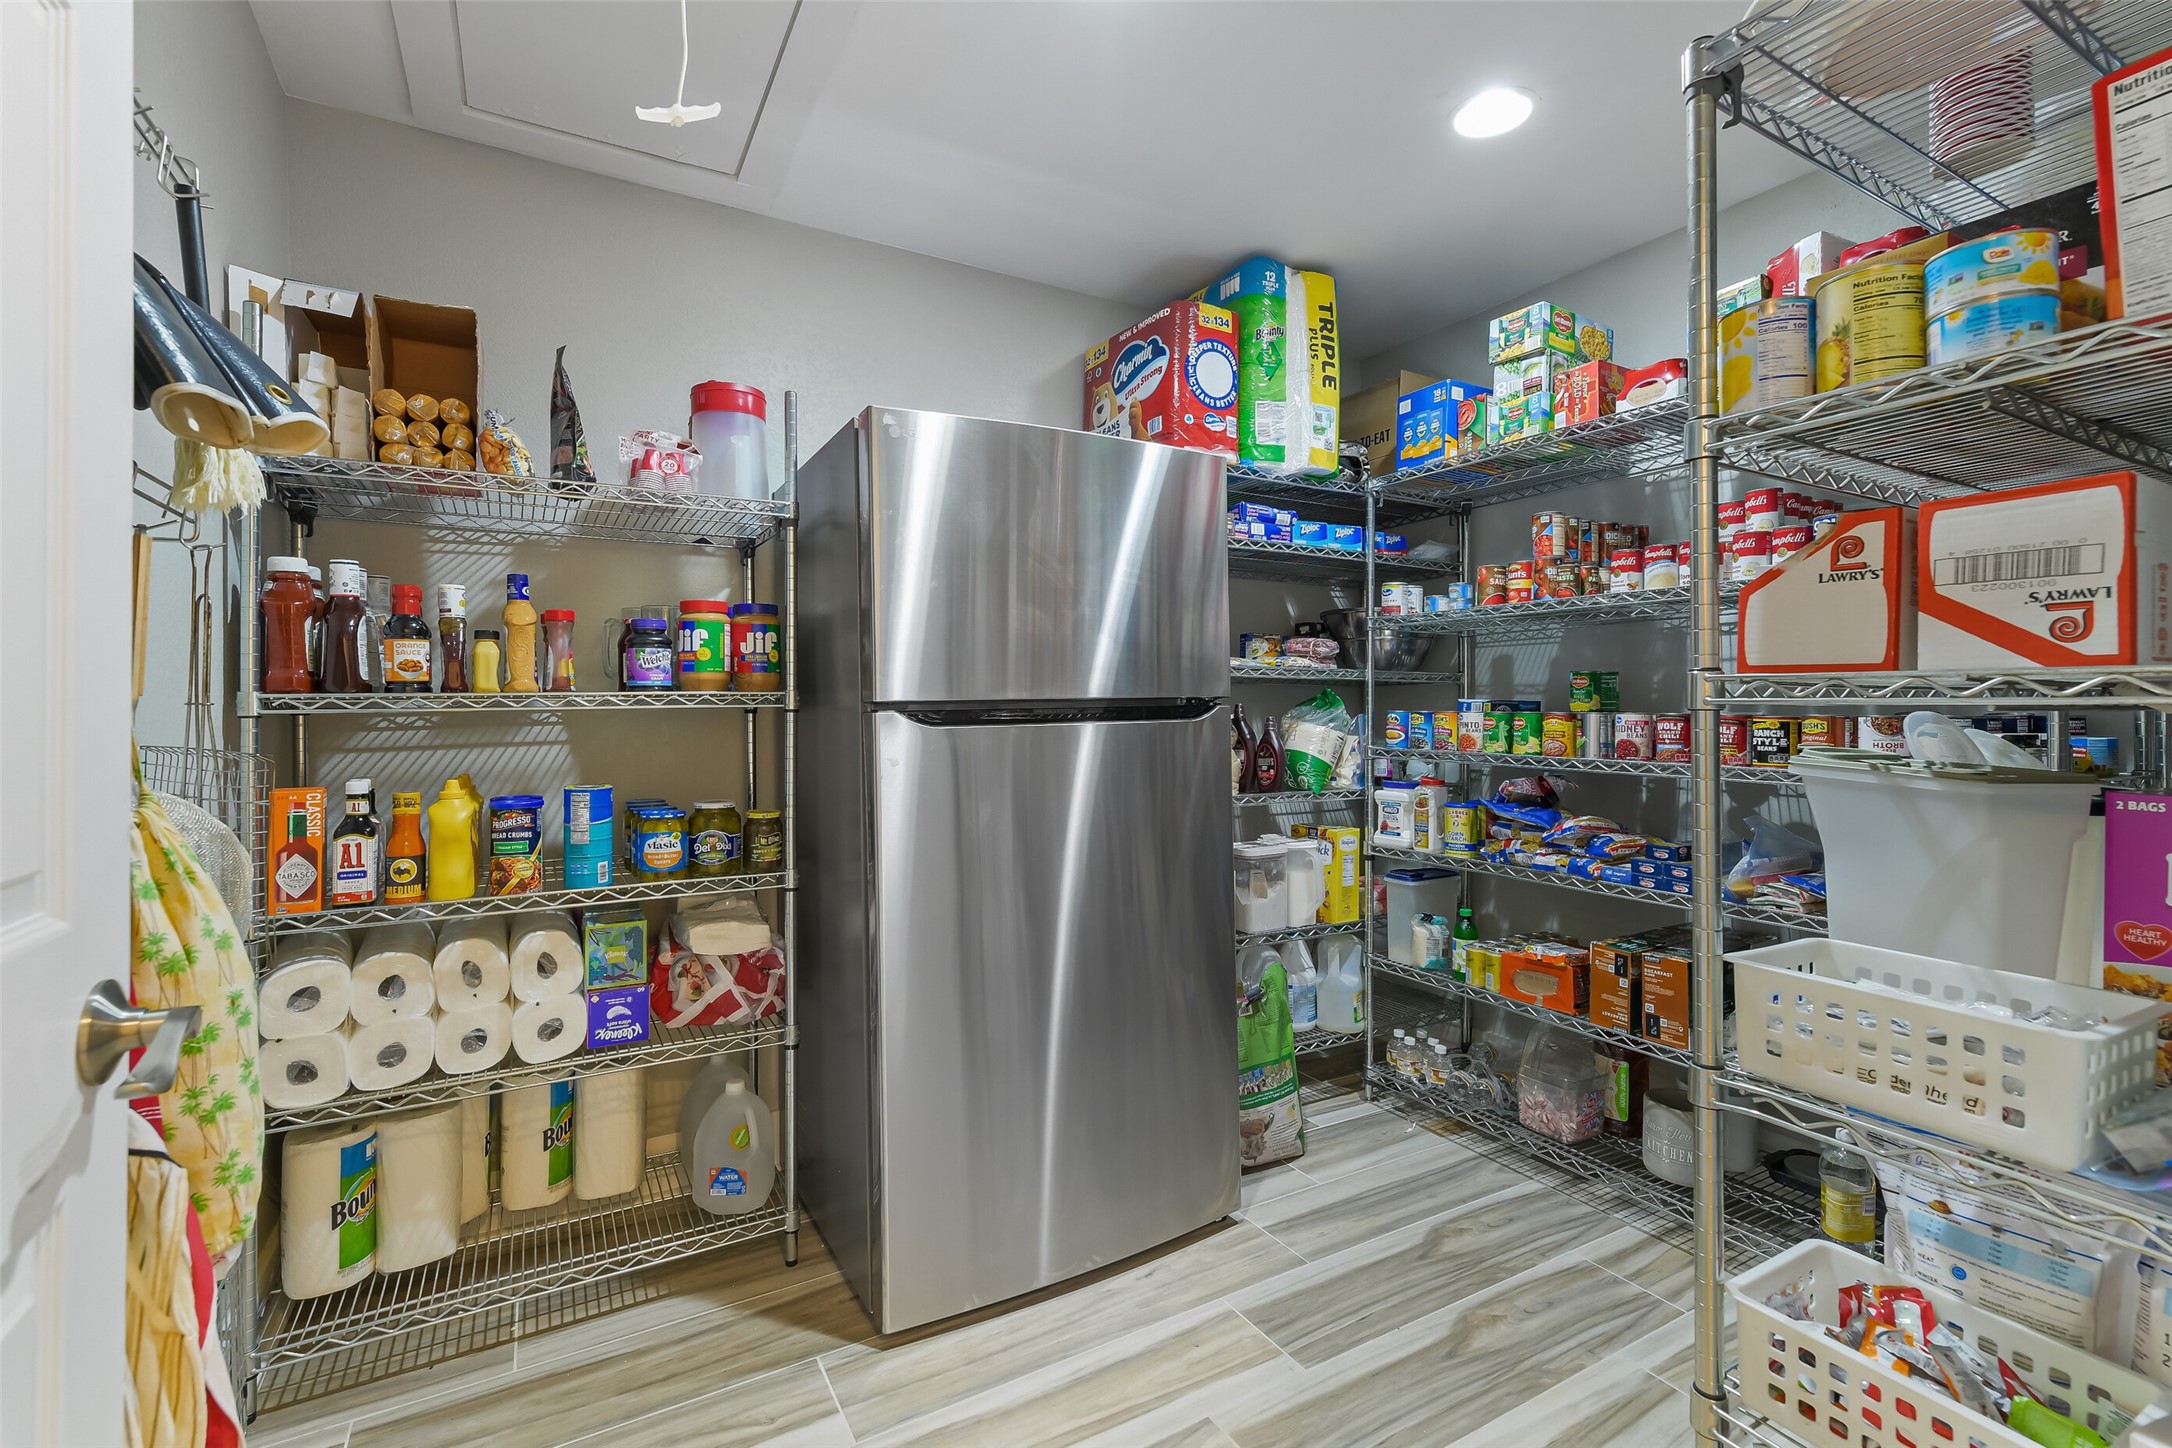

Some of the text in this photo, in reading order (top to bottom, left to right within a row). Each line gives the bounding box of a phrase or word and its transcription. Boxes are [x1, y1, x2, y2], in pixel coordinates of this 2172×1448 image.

[1265, 271, 1276, 281] 12
[1853, 275, 1899, 289] Nutrition
[1119, 330, 1131, 342] NEW
[1138, 308, 1171, 331] IMPROVED
[1213, 316, 1230, 328] 134
[1309, 328, 1318, 360] PLUS
[1318, 302, 1337, 390] TRIPLE
[1093, 345, 1106, 362] 134
[1213, 341, 1238, 372] TEXTURE
[1114, 343, 1153, 389] Charmin
[1125, 365, 1163, 400] Ultra Strong
[1495, 382, 1508, 398] 8
[1300, 523, 1321, 536] Ziploc
[1334, 527, 1356, 540] Ziploc
[1385, 535, 1402, 545] Ziploc
[1506, 570, 1527, 579] unt's
[1818, 569, 1881, 584] LAWRY'S
[2028, 586, 2112, 604] LAWRY'S
[395, 642, 426, 650] ORANGE
[739, 631, 778, 654] Jif
[641, 652, 670, 666] Welch's
[1615, 725, 1646, 733] KIDNEY
[1657, 722, 1684, 731] WOLF
[1753, 729, 1784, 737] RANCH
[1752, 738, 1788, 746] STYLE
[1872, 741, 1905, 749] BROTH
[2116, 801, 2167, 812] 2 BAGS
[306, 793, 321, 837] CLASSIC
[492, 816, 531, 829] PROGRESSO
[508, 831, 533, 839] CRUMBS
[647, 839, 678, 850] vlasic
[278, 870, 315, 880] TABASCO
[386, 884, 423, 895] MEDIUM
[2123, 934, 2168, 946] HEALTHY
[2129, 928, 2162, 939] HEART
[1644, 968, 1673, 977] BREAKFAST
[594, 1022, 643, 1040] Kleenex
[1646, 1138, 1694, 1163] KITCHEN
